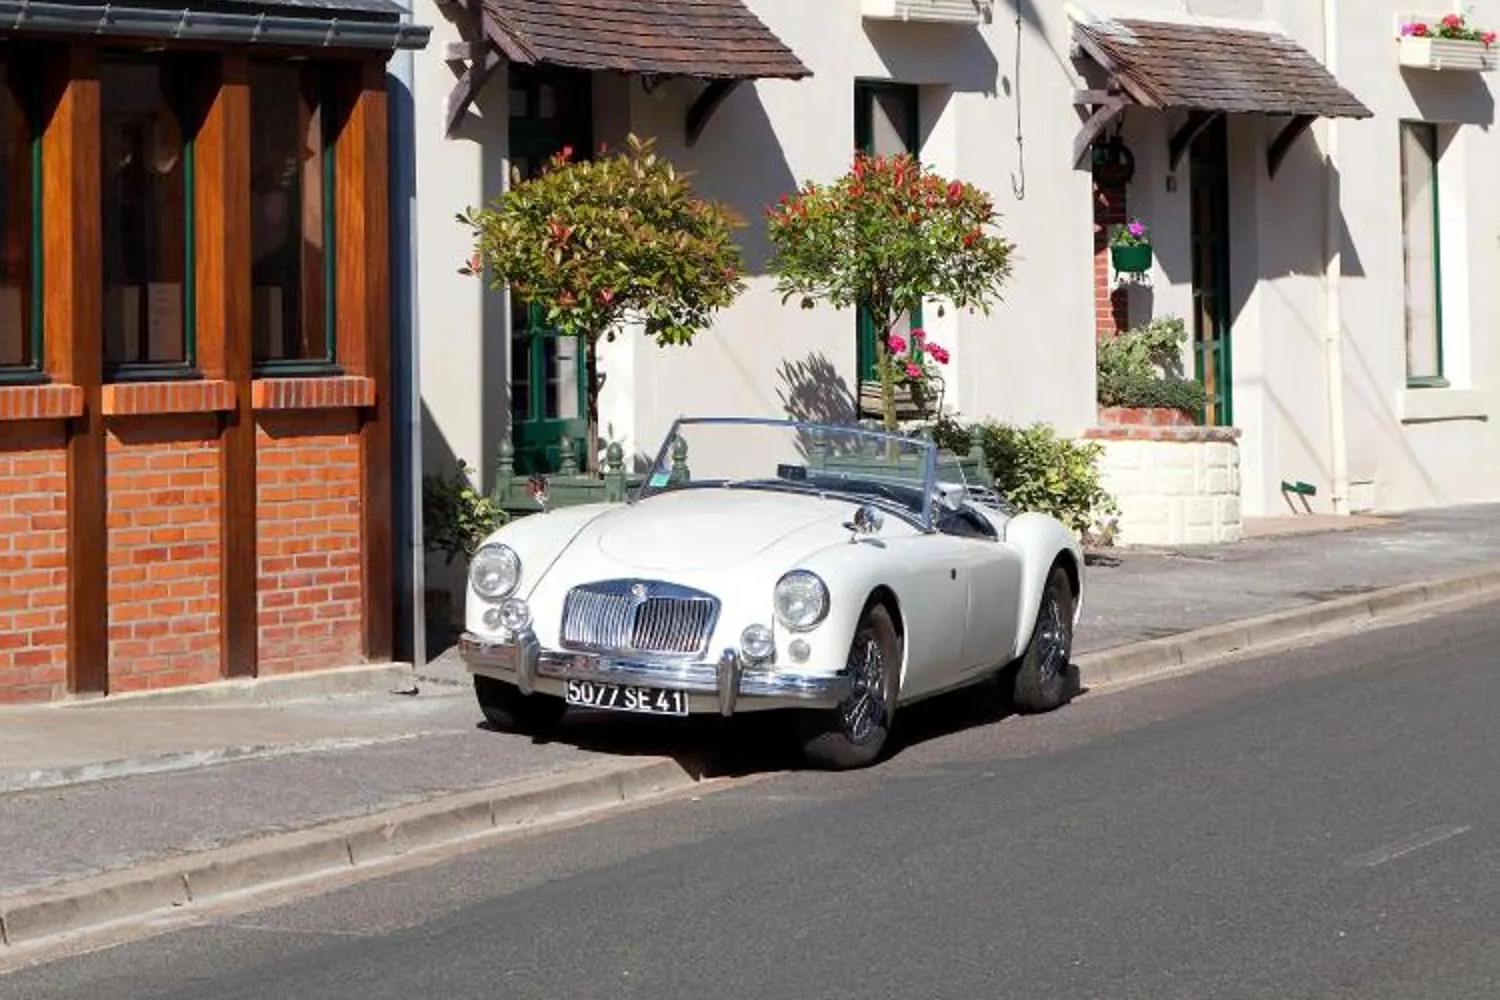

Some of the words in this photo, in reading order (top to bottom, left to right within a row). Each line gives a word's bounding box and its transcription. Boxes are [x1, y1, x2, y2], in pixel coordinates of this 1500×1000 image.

[569, 680, 619, 707] 5077
[625, 687, 652, 711] SE
[656, 689, 682, 713] 41
